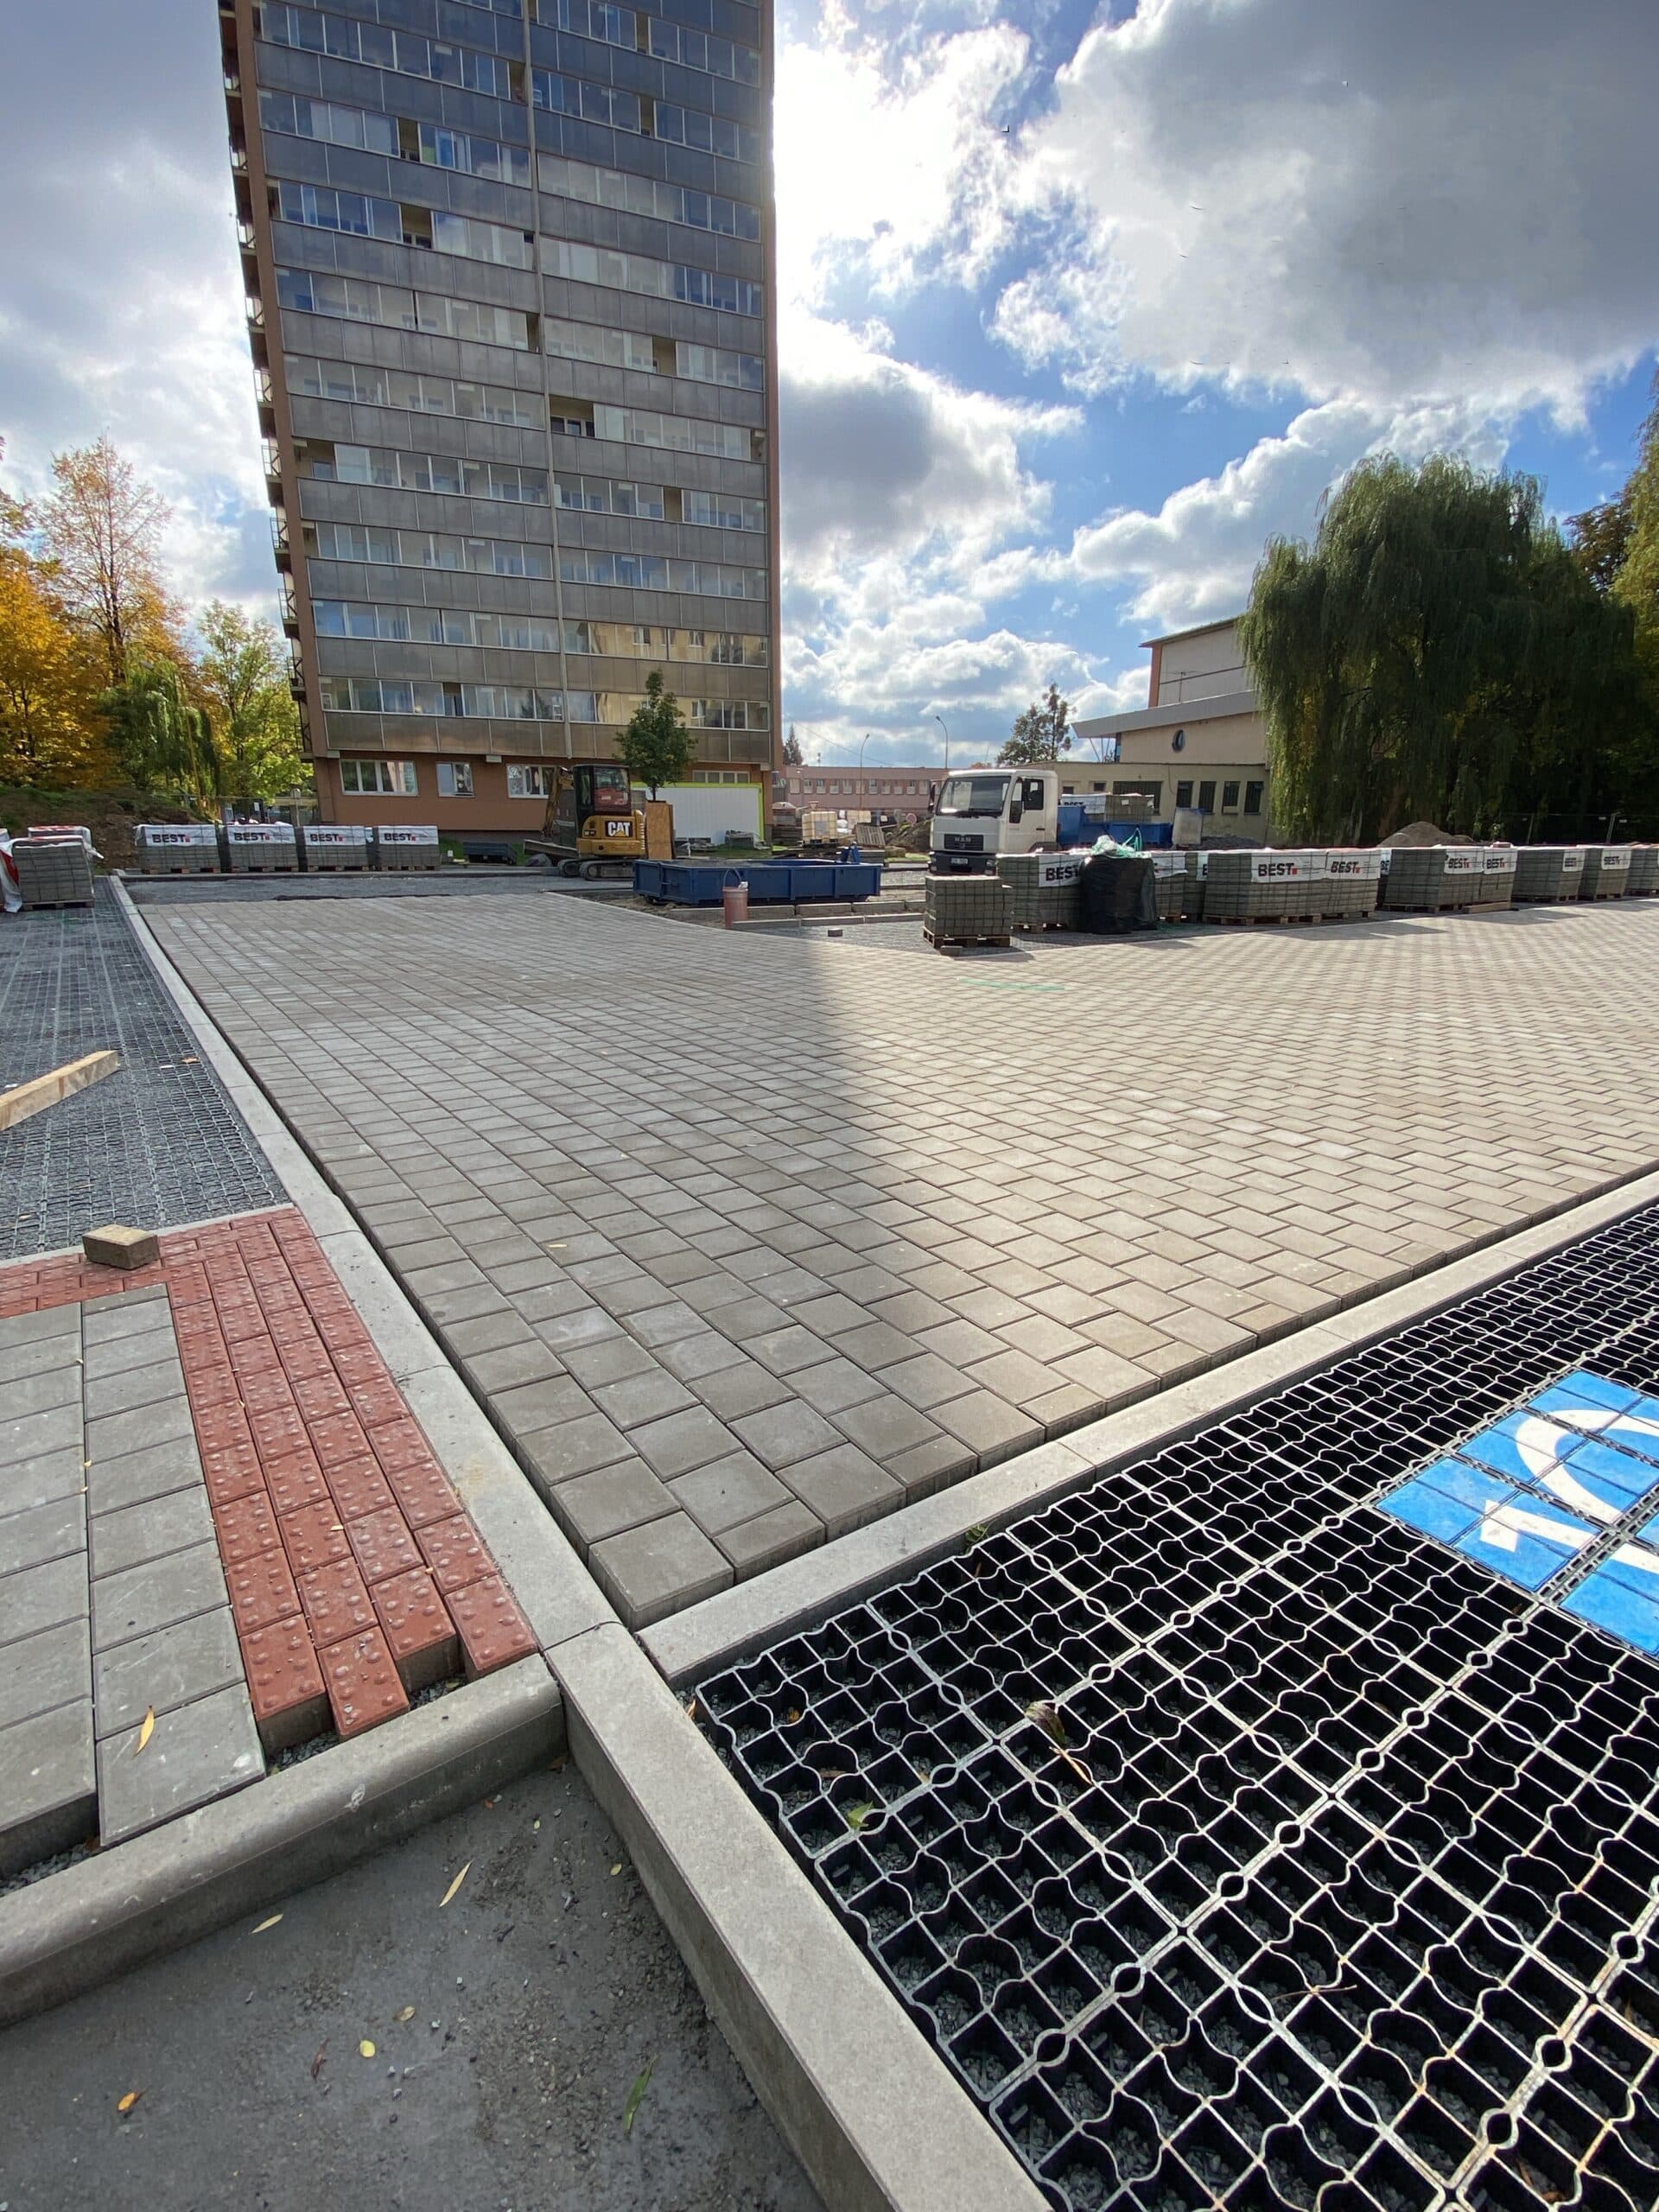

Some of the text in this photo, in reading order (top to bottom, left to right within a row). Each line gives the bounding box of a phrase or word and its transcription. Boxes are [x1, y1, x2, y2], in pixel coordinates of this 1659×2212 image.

[607, 822, 631, 836] CAT
[151, 833, 186, 843] BEST
[233, 832, 266, 842] BEST
[309, 833, 340, 842] BEST
[384, 833, 412, 842] BEST
[1331, 861, 1359, 874] BEST
[1447, 858, 1468, 869] BEST
[1486, 857, 1504, 869] BEST
[1258, 862, 1295, 877] BEST
